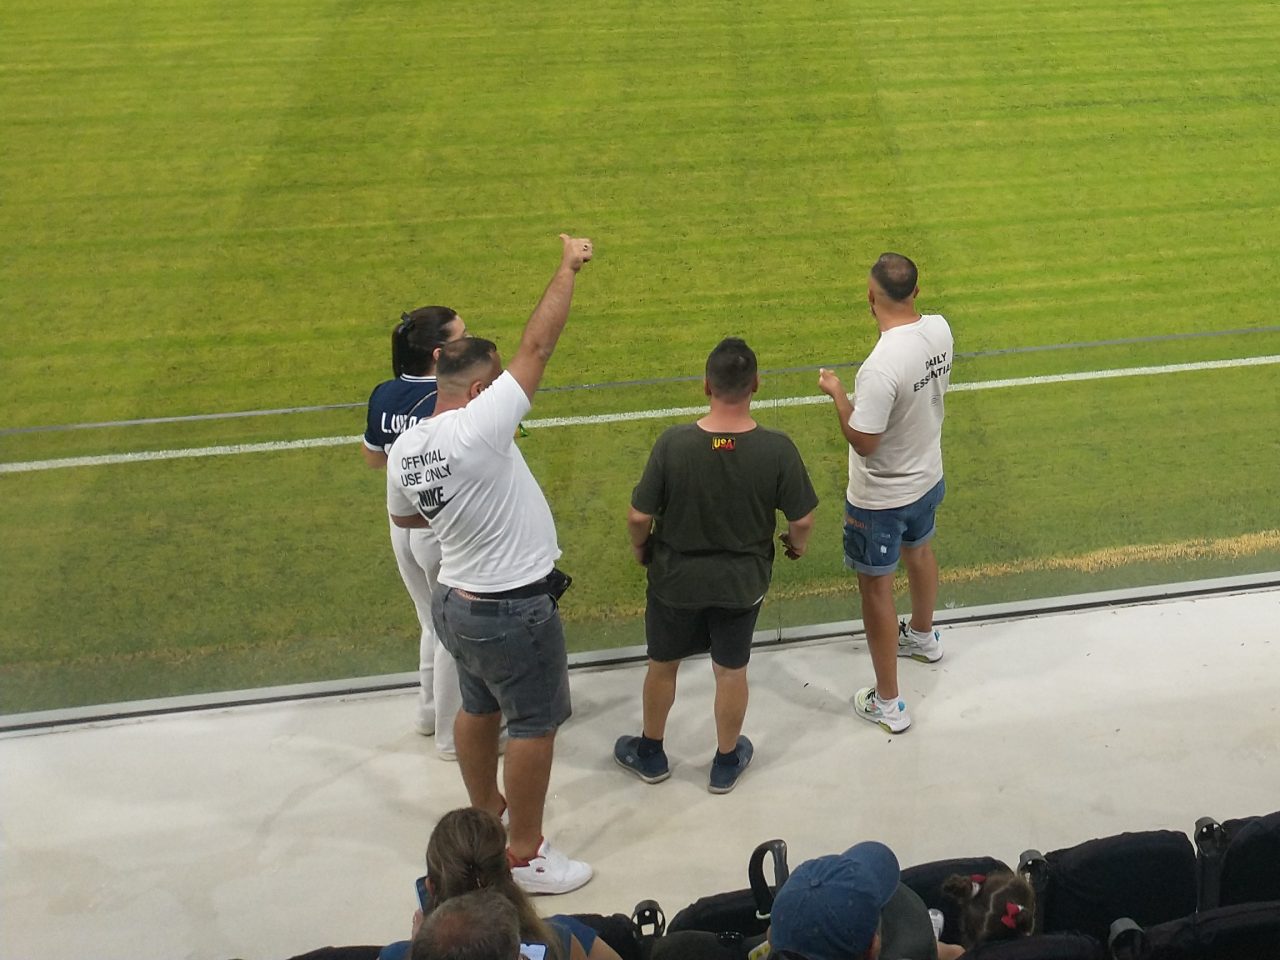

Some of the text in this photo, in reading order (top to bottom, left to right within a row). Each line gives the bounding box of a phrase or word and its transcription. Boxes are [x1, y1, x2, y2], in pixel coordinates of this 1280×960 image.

[925, 352, 947, 371] DAILY
[401, 449, 446, 470] OFFICIAL
[401, 464, 452, 487] USE ONLY
[417, 486, 443, 507] NIKE
